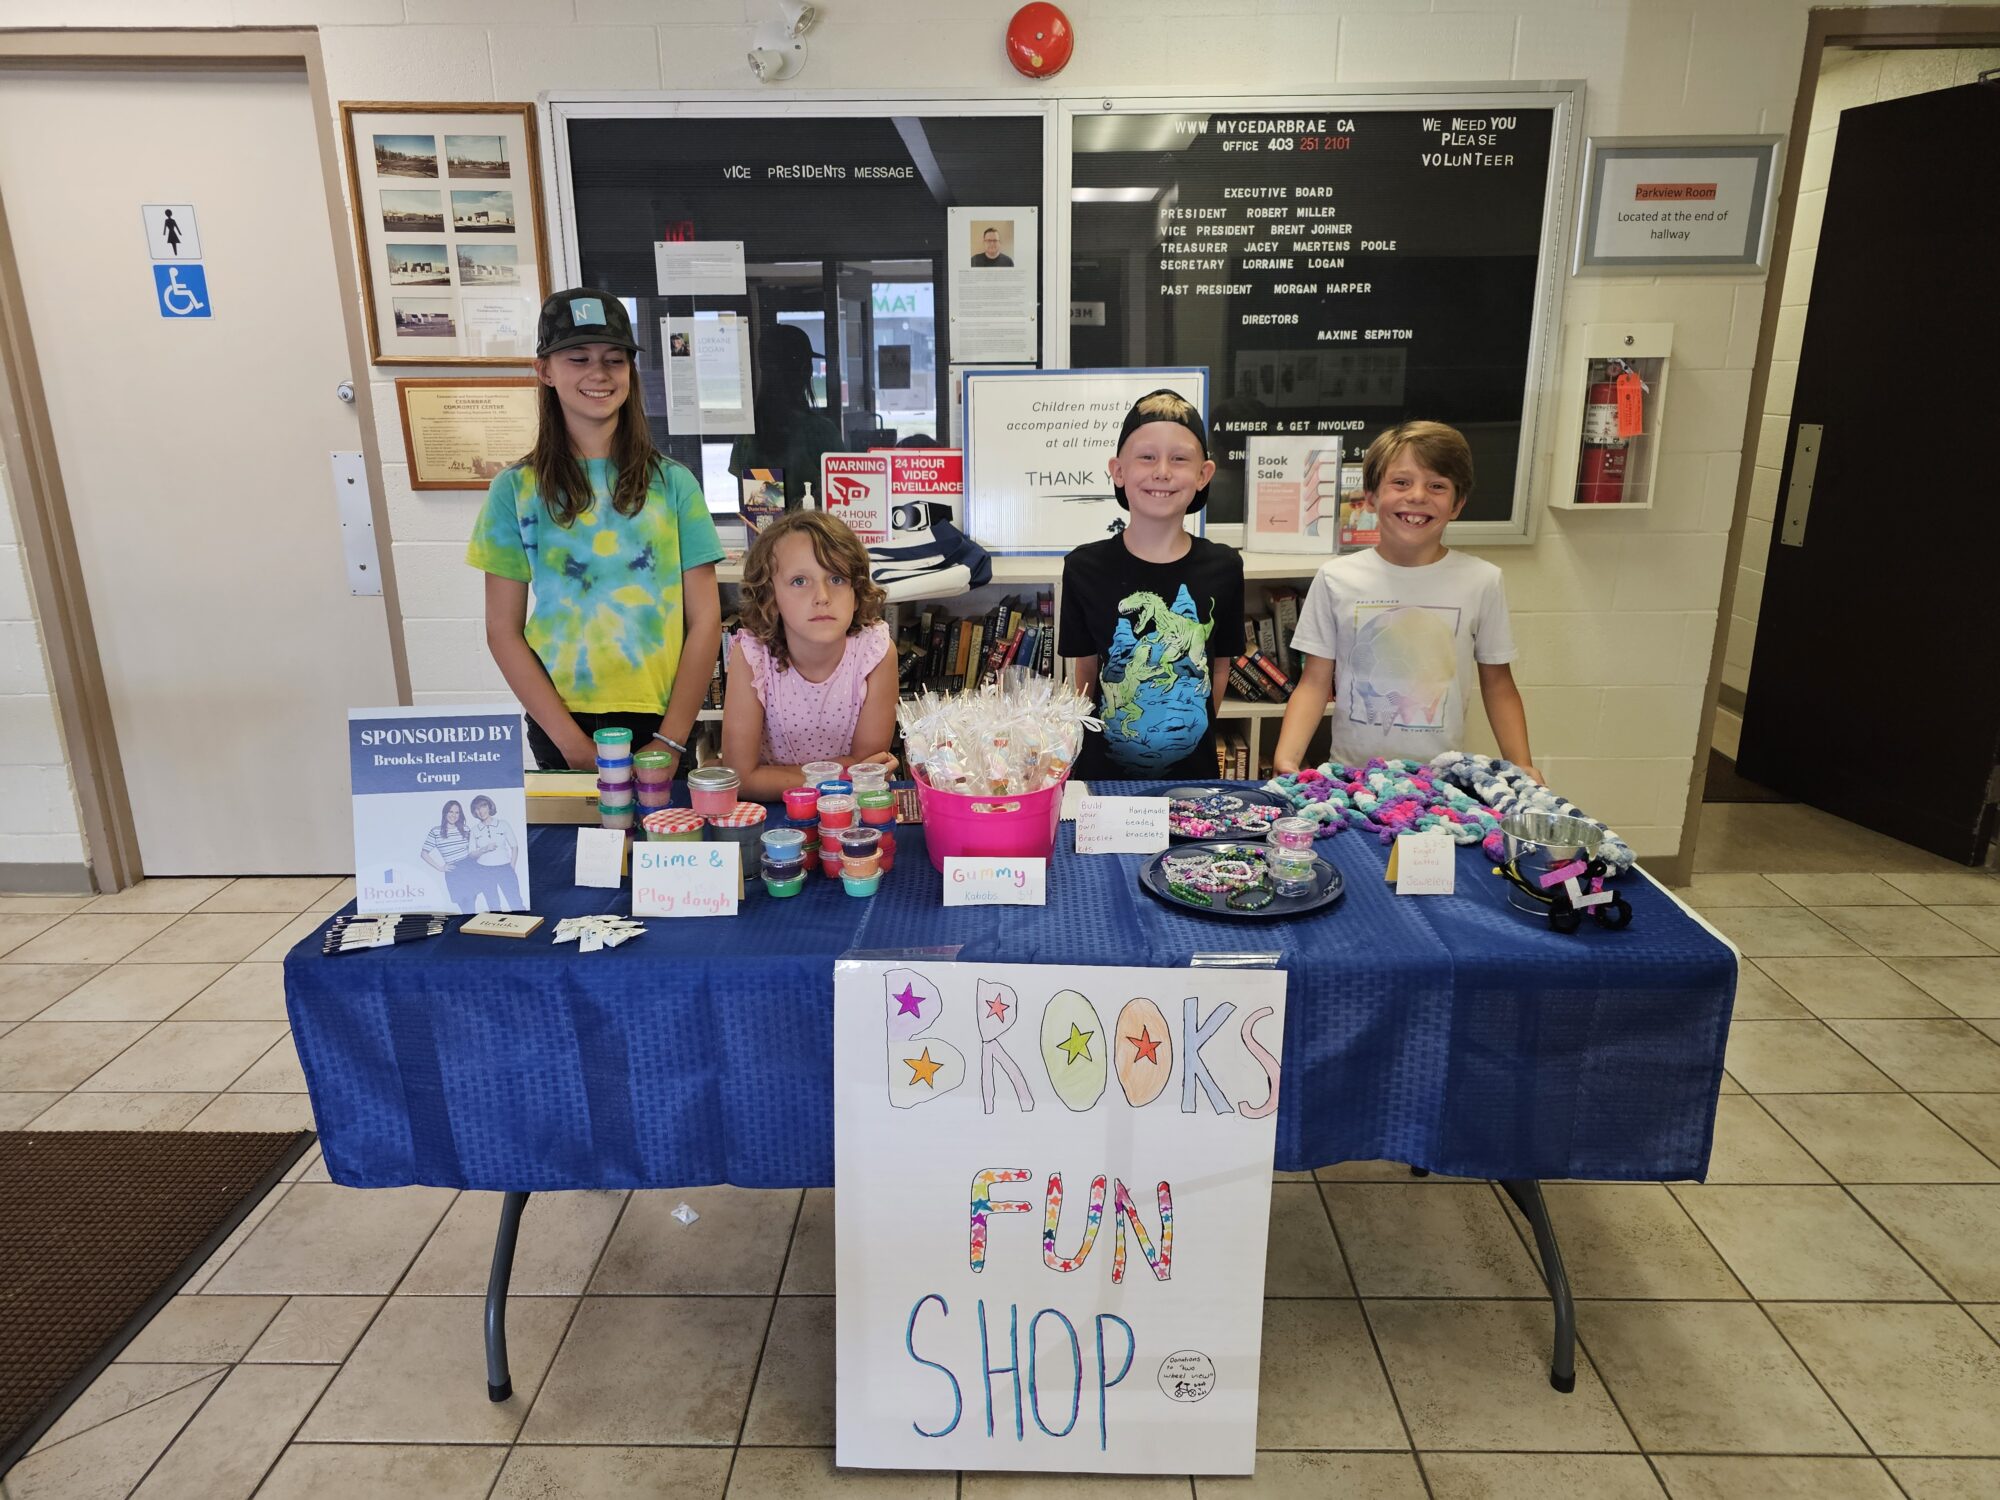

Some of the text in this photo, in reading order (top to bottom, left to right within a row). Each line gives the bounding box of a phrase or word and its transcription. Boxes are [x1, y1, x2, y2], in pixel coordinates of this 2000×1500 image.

[1175, 119, 1355, 134] WWW MYCEDARBRAE CA
[1422, 117, 1516, 132] WE NEED YOU
[1223, 137, 1350, 152] OFFICE 403 251 2101
[1441, 133, 1496, 147] PLEASE
[1422, 153, 1514, 167] VOLUNTEER
[724, 165, 914, 180] VICE PRESIDENTS MESSAGE
[1224, 186, 1333, 199] EXECUTIVE BOARD
[1636, 187, 1716, 199] Parkview Room
[1161, 207, 1336, 220] PRESIDENT ROBERT MILLER
[1618, 210, 1728, 222] Located at the end of
[1161, 223, 1352, 237] VICE PRESIDENT BRENT JOHNER
[1651, 228, 1690, 241] hallway
[1161, 240, 1397, 254] TREASURER JACEY MAERTENS POOLE
[1160, 257, 1344, 270] SECRETARY LORRAINE LOGAN
[1161, 282, 1372, 295] PAST PRESIDENT MORGAN HARPER
[1242, 313, 1299, 326] DIRECTORS
[1318, 328, 1412, 341] MAXINE SEPHTON
[1032, 401, 1085, 413] Children
[1090, 402, 1120, 412] must
[1007, 420, 1089, 431] accompanied
[1094, 420, 1108, 431] by
[1214, 421, 1365, 432] A MEMBER & GET INVOLVED
[1046, 438, 1116, 448] at all times
[1229, 450, 1246, 460] SIN
[1258, 456, 1288, 466] Book
[828, 461, 885, 472] WARNING
[895, 459, 945, 469] 24 HOUR
[903, 470, 937, 480] VIDEO
[1025, 471, 1094, 487] THANK
[1258, 470, 1284, 479] Sale
[893, 482, 963, 492] RVEILLANCE
[1346, 475, 1362, 489] my
[836, 511, 878, 519] 24 HOUR
[361, 726, 513, 747] SPONSORED BY
[374, 751, 501, 767] Brooks Real Estate
[417, 772, 461, 785] Group
[1082, 802, 1102, 810] Build
[1129, 806, 1166, 815] Handmade
[1080, 813, 1097, 824] your
[1126, 819, 1155, 827] beaded
[1126, 831, 1165, 839] bracelets
[641, 850, 723, 869] Slime &
[953, 868, 1026, 888] Gummy
[364, 885, 425, 900] Brooks
[638, 889, 730, 914] Play dough
[883, 968, 1283, 1120] BROOKS
[971, 1168, 1173, 1284] FUN
[906, 1294, 1136, 1451] SHOP
